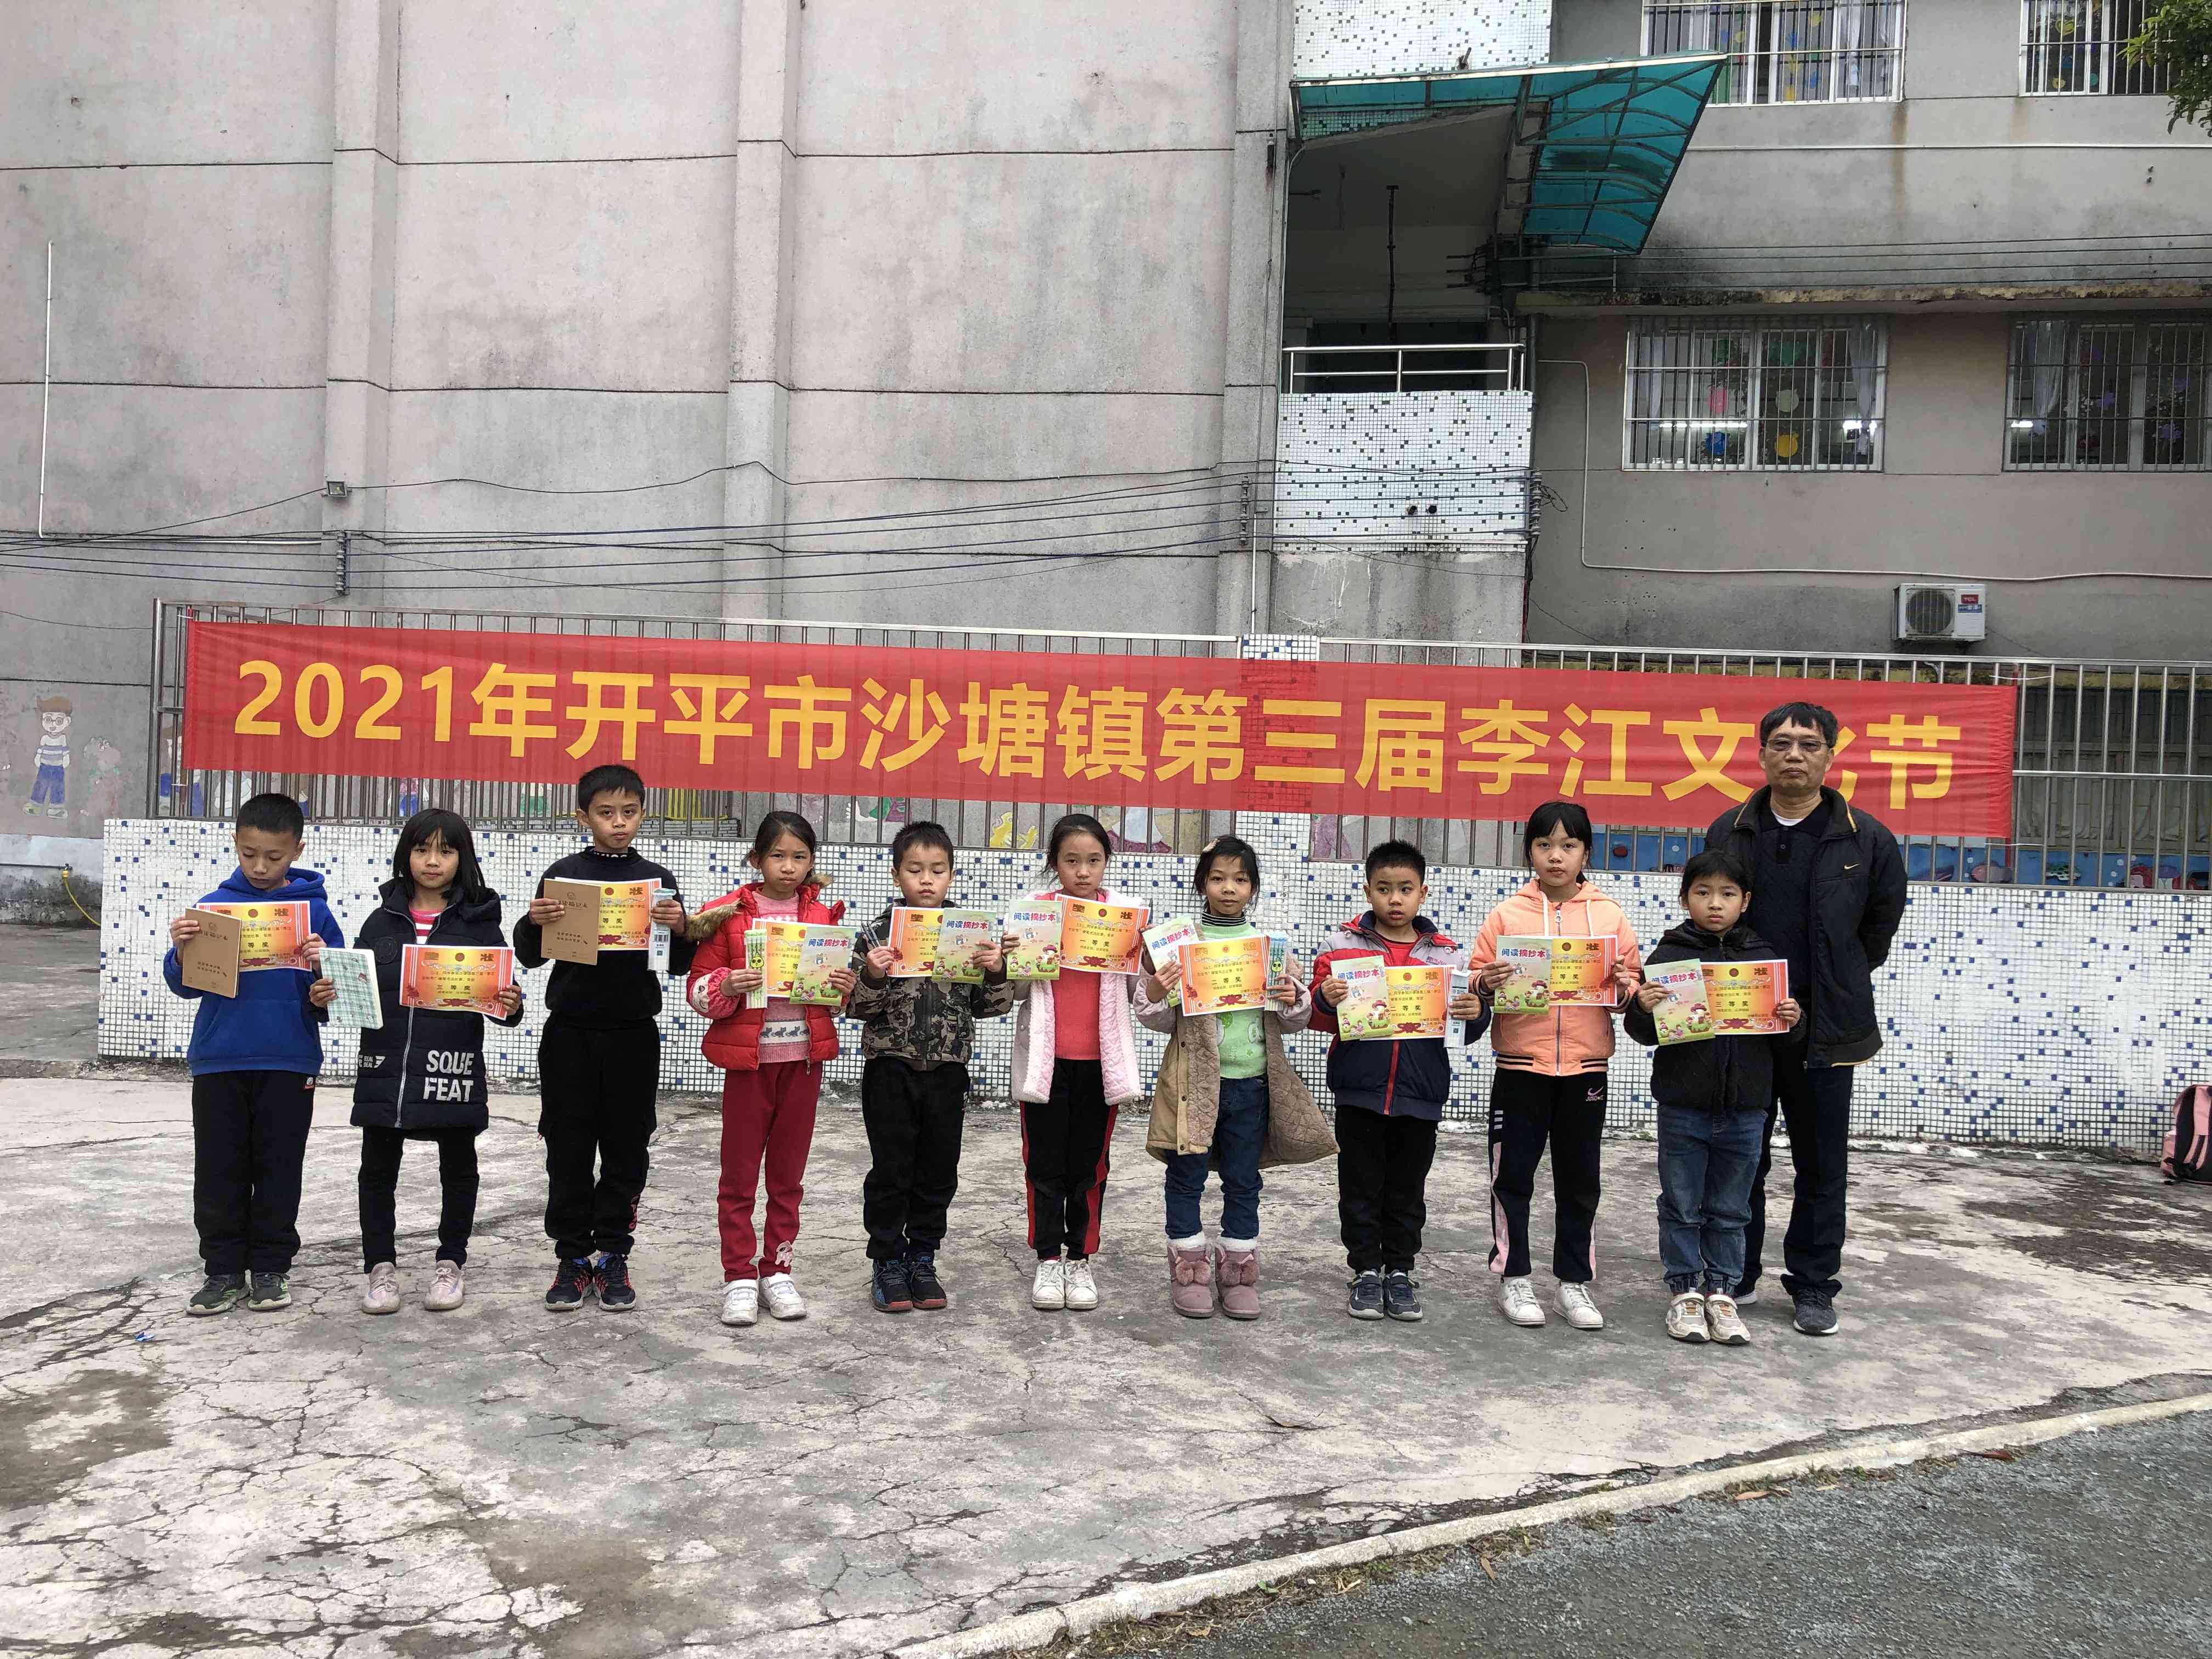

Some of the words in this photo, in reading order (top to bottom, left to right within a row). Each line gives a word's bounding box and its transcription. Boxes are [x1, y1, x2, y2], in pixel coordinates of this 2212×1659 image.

[1013, 912, 1057, 922] 阅读摘抄本
[946, 920, 988, 929] 阅读摘抄本
[808, 938, 849, 947] 阅读摘抄本
[1152, 927, 1190, 950] 阅读摘抄本
[1501, 948, 1547, 958] 阅读摘抄本
[1337, 968, 1380, 980] 阅读摘抄本
[426, 1049, 475, 1075] SQUE
[422, 1077, 474, 1102] FEAT
